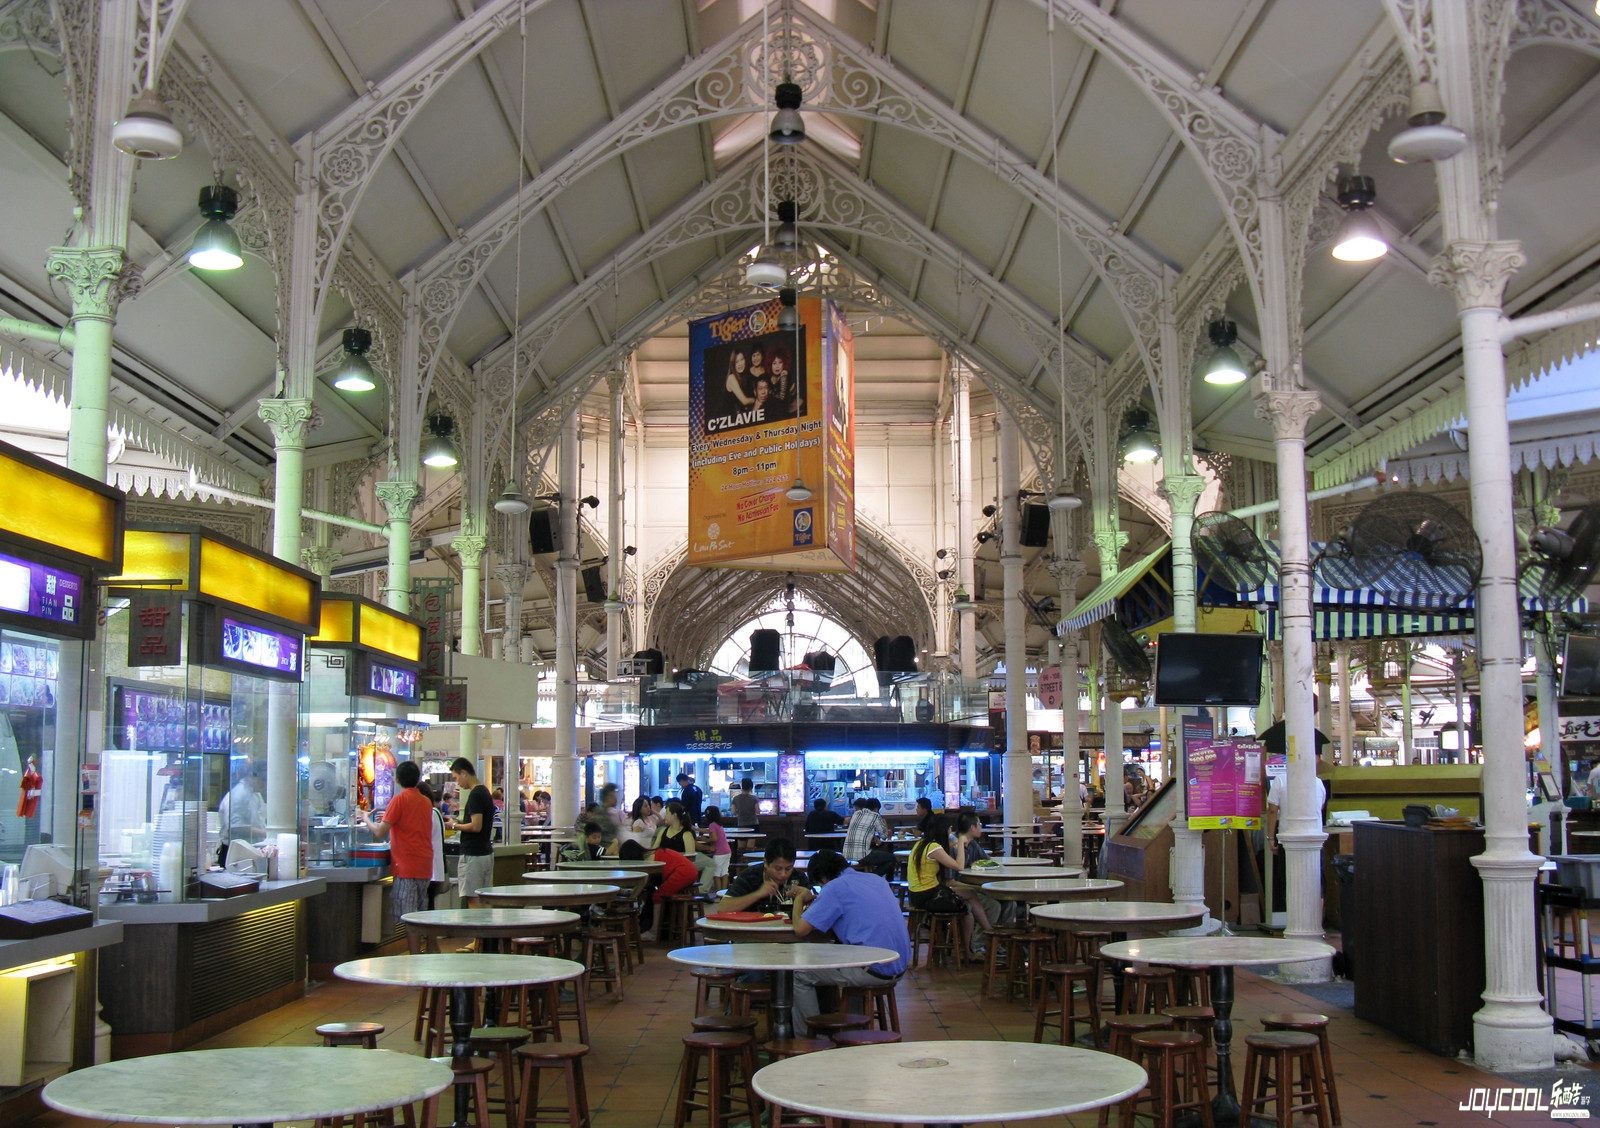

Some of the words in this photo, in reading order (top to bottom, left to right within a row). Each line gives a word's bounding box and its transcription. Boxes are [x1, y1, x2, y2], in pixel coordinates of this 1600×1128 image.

[709, 315, 746, 341] Tiger
[691, 443, 711, 452] Every
[712, 435, 753, 448] Wednesday
[756, 432, 761, 440] &
[764, 426, 798, 438] Thursday
[801, 420, 822, 432] Night
[692, 455, 727, 468] (including
[729, 452, 742, 461] Eve
[744, 448, 757, 458] and
[760, 444, 782, 455] Public
[785, 436, 821, 451] Holdays)
[733, 466, 749, 477] 8pm
[756, 462, 777, 473] 11pm
[736, 502, 744, 510] No
[744, 498, 758, 508] Cover
[759, 493, 776, 503] Charge
[738, 513, 745, 521] No
[746, 506, 770, 519] Admission
[770, 503, 779, 511] Fee
[795, 533, 811, 544] Tiger
[42, 596, 58, 607] TIAN
[42, 605, 52, 616] PIN
[138, 606, 171, 655] 甜品
[1040, 681, 1058, 693] STREET
[694, 729, 722, 741] 甜品
[686, 742, 733, 750] DESSERTS
